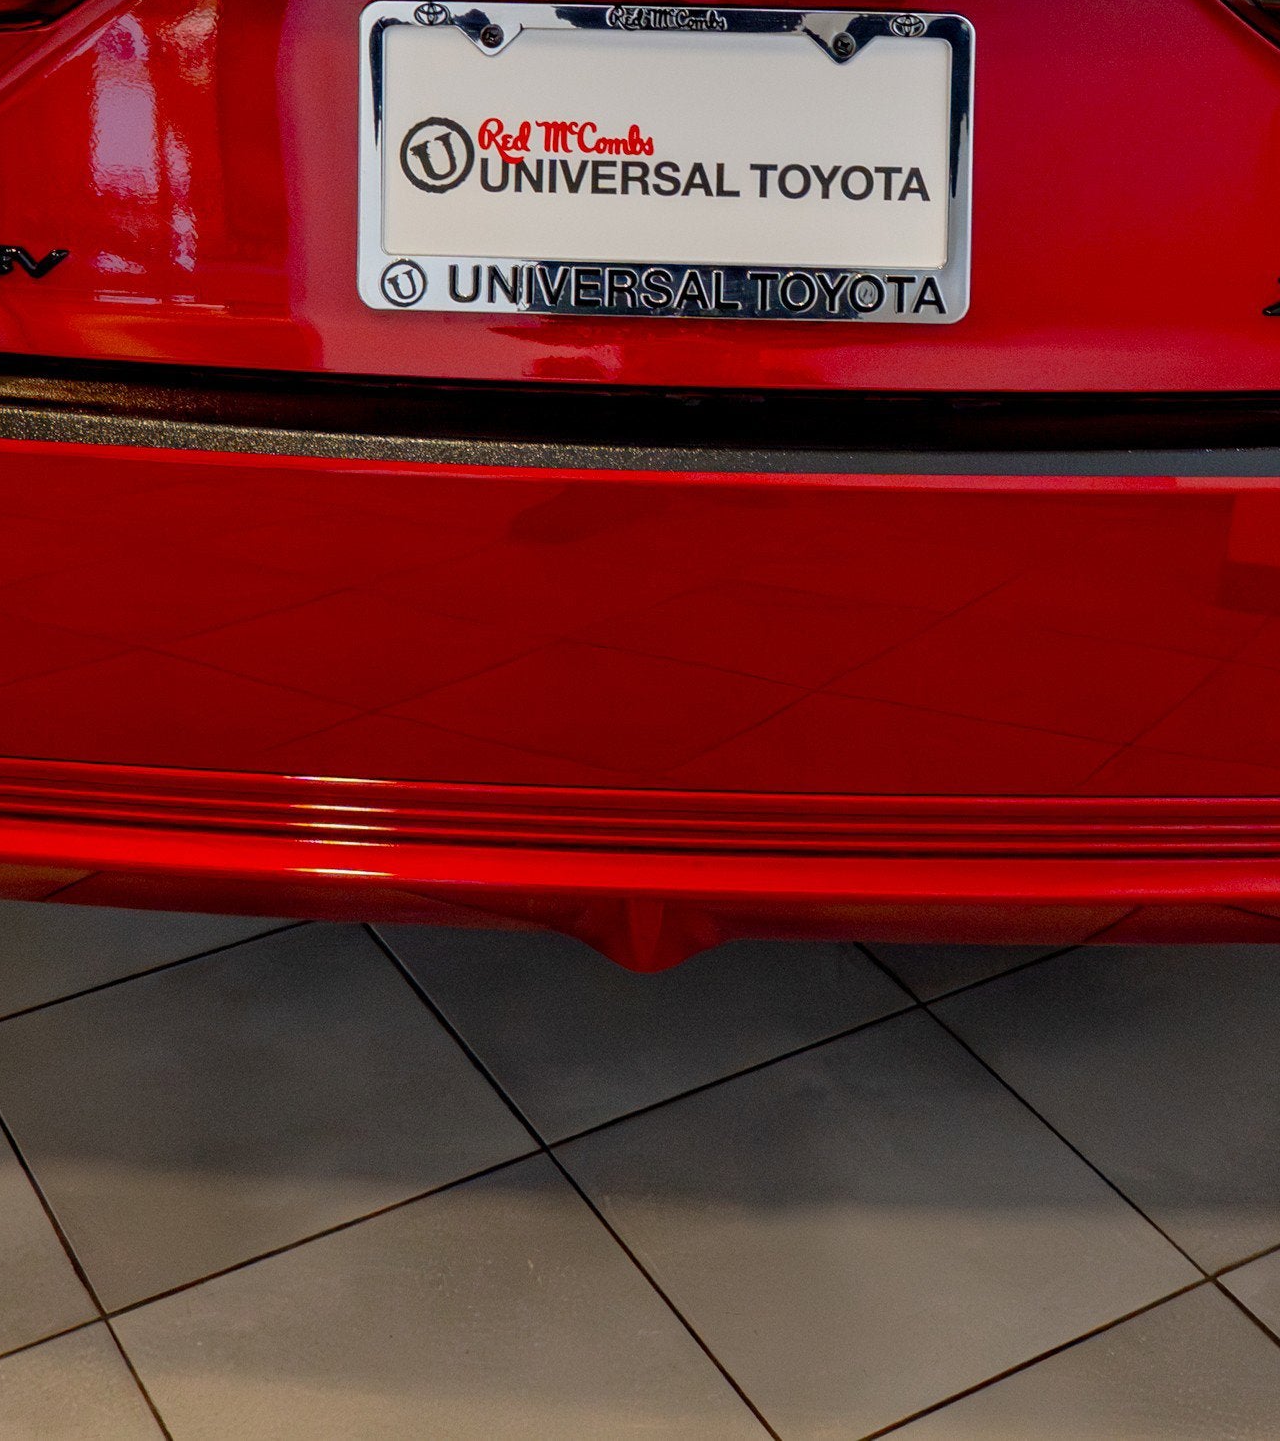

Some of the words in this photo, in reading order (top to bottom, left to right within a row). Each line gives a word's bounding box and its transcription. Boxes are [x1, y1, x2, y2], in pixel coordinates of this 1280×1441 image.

[606, 6, 647, 31] Red
[478, 118, 532, 165] Red
[535, 121, 654, 156] McCombs
[480, 158, 740, 198] UNIVERSAL
[750, 162, 931, 202] TOYOTA
[448, 264, 742, 310] UNIVERSAL
[748, 271, 947, 315] TOYOTA
